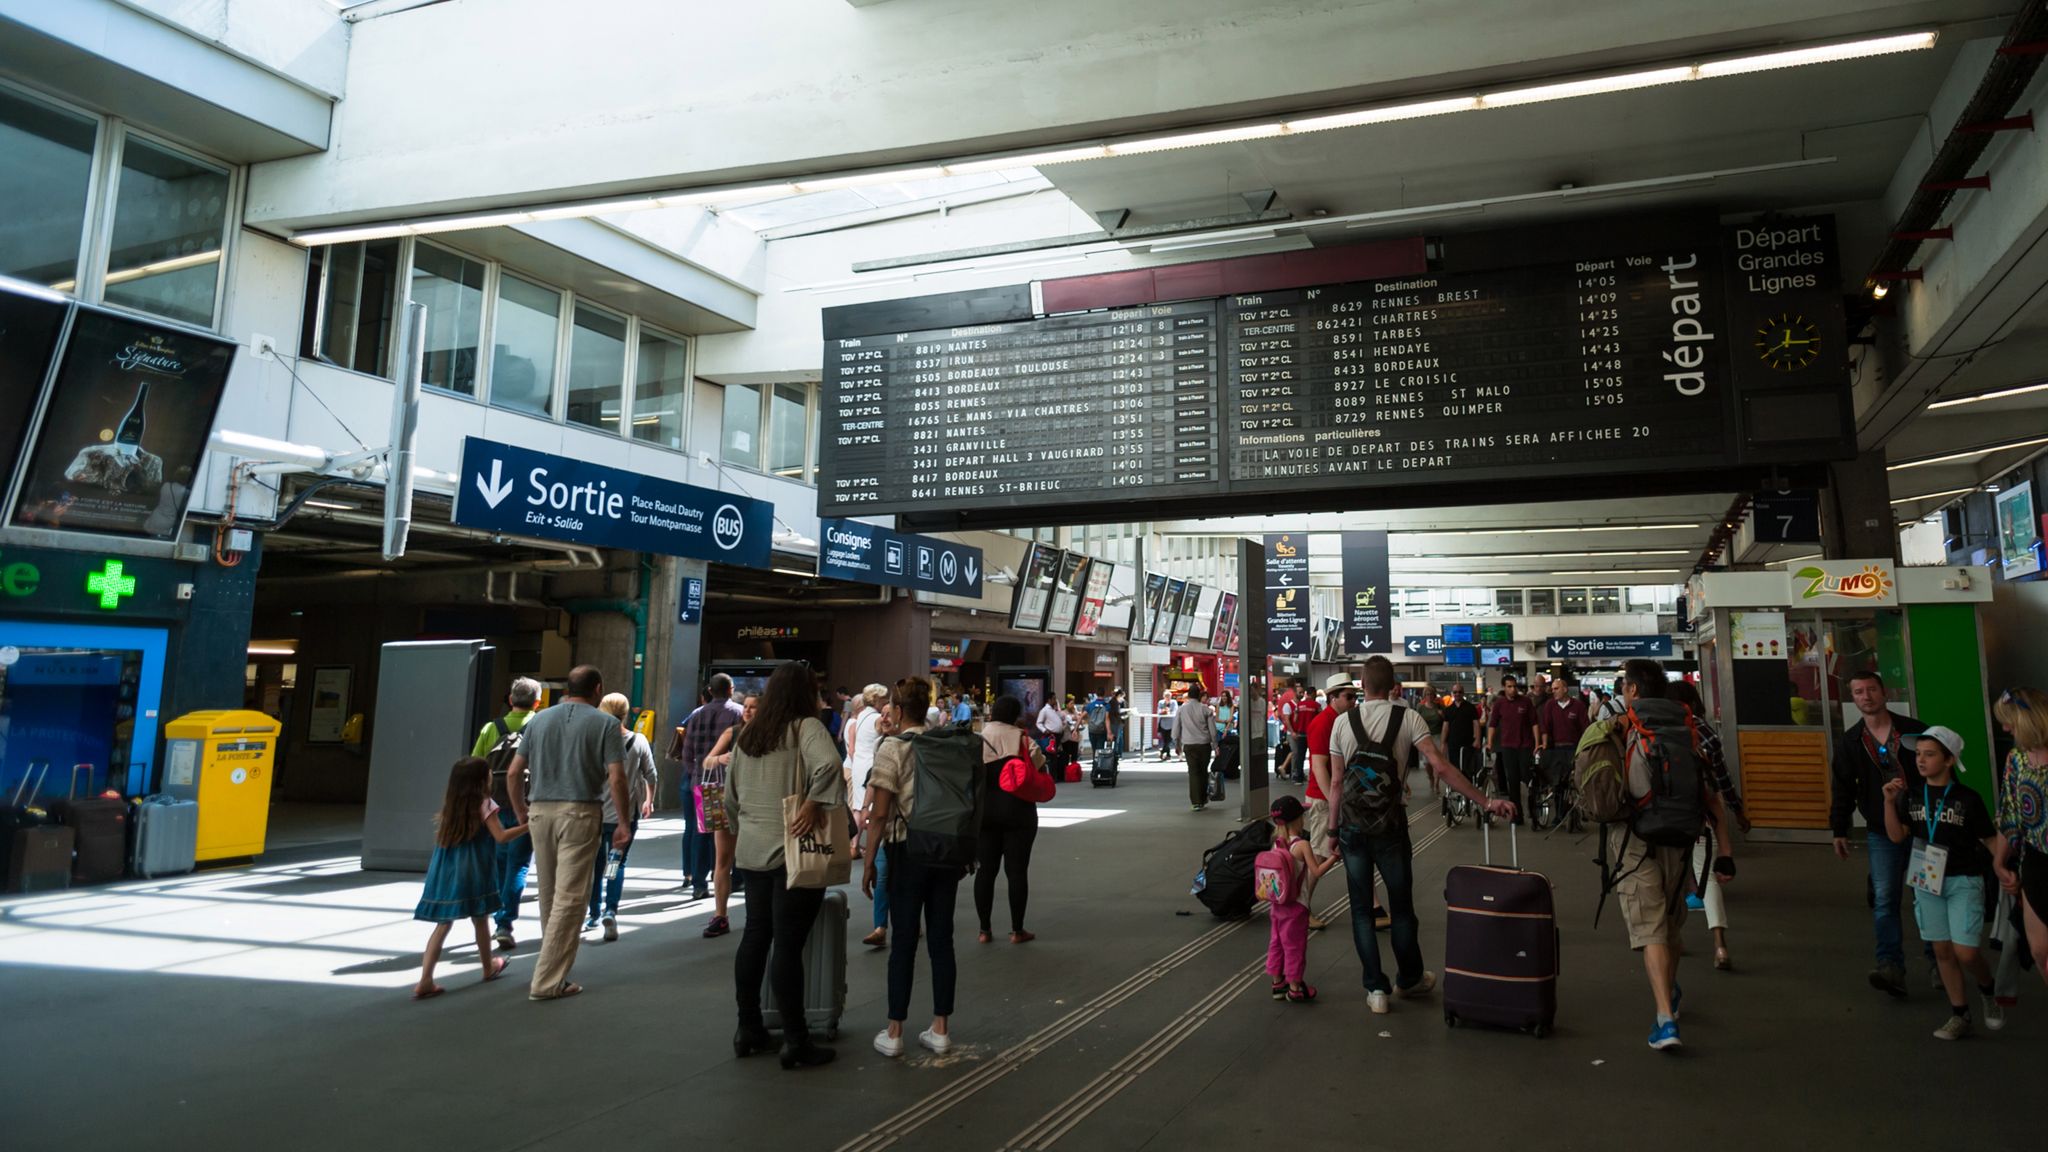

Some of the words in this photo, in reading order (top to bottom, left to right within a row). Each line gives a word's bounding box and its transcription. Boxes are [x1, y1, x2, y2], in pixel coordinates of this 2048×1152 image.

[1737, 224, 1820, 250] Départ
[1738, 249, 1824, 271] Grandes
[1237, 295, 1262, 306] Train
[1375, 277, 1437, 293] Destination
[1576, 260, 1614, 273] Départ
[1626, 255, 1652, 267] Voie
[1748, 274, 1816, 294] Lignes
[1240, 312, 1256, 321] TGV
[1332, 301, 1362, 312] 8629
[1372, 295, 1419, 309] RENNES
[1439, 289, 1479, 303] BREST
[840, 338, 861, 348] Train
[952, 325, 1001, 336] Destination
[1112, 310, 1142, 321] Départ
[1152, 306, 1172, 315] Voie
[1244, 323, 1295, 336] TER-CENTRE
[1317, 317, 1362, 330] 862421
[1373, 310, 1437, 325] CHARTRES
[1660, 253, 1714, 396] départ
[916, 344, 942, 355] 8819
[948, 340, 987, 351] NANTES
[1159, 321, 1165, 330] 8
[1240, 343, 1257, 352] TGV
[1333, 333, 1362, 344] 8591
[1374, 327, 1421, 341] TARBES
[112, 345, 184, 372] Signature
[916, 358, 941, 369] 8537
[949, 355, 974, 365] IRUN
[1159, 336, 1165, 345] 3
[1241, 358, 1257, 367] TGV
[1334, 349, 1363, 360] 8541
[1374, 342, 1430, 357] HENDAYE
[916, 372, 941, 383] 8505
[948, 367, 999, 380] BORDEAUX
[1016, 360, 1068, 374] TOULOUSE
[1159, 351, 1165, 360] 3
[1241, 374, 1257, 383] TGV
[1334, 364, 1364, 376] 8433
[1374, 358, 1439, 372] BORDEAUX
[915, 386, 940, 397] 8413
[947, 382, 999, 394] BORDEAUX
[1241, 389, 1257, 398] TGV
[1334, 380, 1365, 392] 8927
[1375, 377, 1390, 388] LE
[1400, 373, 1457, 387] CROISIC
[915, 401, 940, 412] 8055
[947, 398, 986, 409] RENNES
[1241, 405, 1258, 414] TGV
[1335, 396, 1365, 407] 8089
[1376, 392, 1424, 405] RENNES
[1451, 387, 1466, 398] ST
[1476, 385, 1510, 397] MALO
[842, 420, 884, 431] TER-CENTRE
[909, 415, 940, 426] 16765
[947, 413, 961, 423] LE
[967, 411, 992, 422] MANS
[1008, 408, 1027, 418] VIA
[1035, 403, 1089, 416] CHARTRES
[1241, 421, 1258, 429] TGV
[1335, 412, 1366, 424] 8729
[1376, 408, 1424, 420] RENNES
[1443, 402, 1502, 416] QUIMPER
[838, 436, 852, 446] TGV
[914, 429, 939, 440] 8821
[946, 426, 985, 437] NANTES
[914, 444, 938, 454] 3431
[946, 439, 1005, 452] GRANVILLE
[1240, 432, 1304, 445] Informations
[1315, 427, 1381, 441] particulières
[1265, 450, 1279, 460] LA
[1288, 447, 1318, 458] VOIE
[1329, 446, 1342, 456] DE
[1352, 442, 1400, 455] DEPART
[1411, 440, 1434, 451] DES
[1445, 436, 1495, 449] TRAINS
[1506, 433, 1539, 445] SERA
[1550, 427, 1621, 442] AFFICHEE
[1633, 426, 1650, 437] 20
[913, 458, 938, 469] 3431
[946, 455, 986, 467] DEPART
[993, 453, 1018, 463] HALL
[1027, 452, 1032, 461] 3
[1041, 446, 1104, 460] VAUGIRARD
[1265, 463, 1318, 476] MINUTES
[1329, 460, 1367, 472] AVANT
[1378, 458, 1393, 469] LE
[1403, 455, 1452, 468] DEPART
[836, 478, 851, 487] TGV
[913, 473, 938, 484] 8417
[946, 469, 998, 481] BORDEAUX
[527, 467, 623, 519] Sortie
[836, 493, 850, 502] TGV
[912, 488, 936, 498] 8641
[945, 485, 984, 496] RENNES
[1000, 480, 1060, 493] ST-BRIEUC
[526, 512, 545, 526] Exit
[554, 516, 583, 530] Salida
[632, 496, 653, 510] Place
[655, 500, 677, 514] Raoul
[678, 504, 704, 521] Dautry
[631, 511, 647, 524] Tour
[649, 515, 702, 534] Montparnasse
[717, 517, 740, 536] BUS
[1776, 515, 1794, 538] 7
[827, 527, 871, 550] Consignes
[0, 561, 40, 597] e
[1793, 567, 1881, 599] ZUMO
[1568, 639, 1604, 651] Sortie
[229, 752, 250, 760] POSTE
